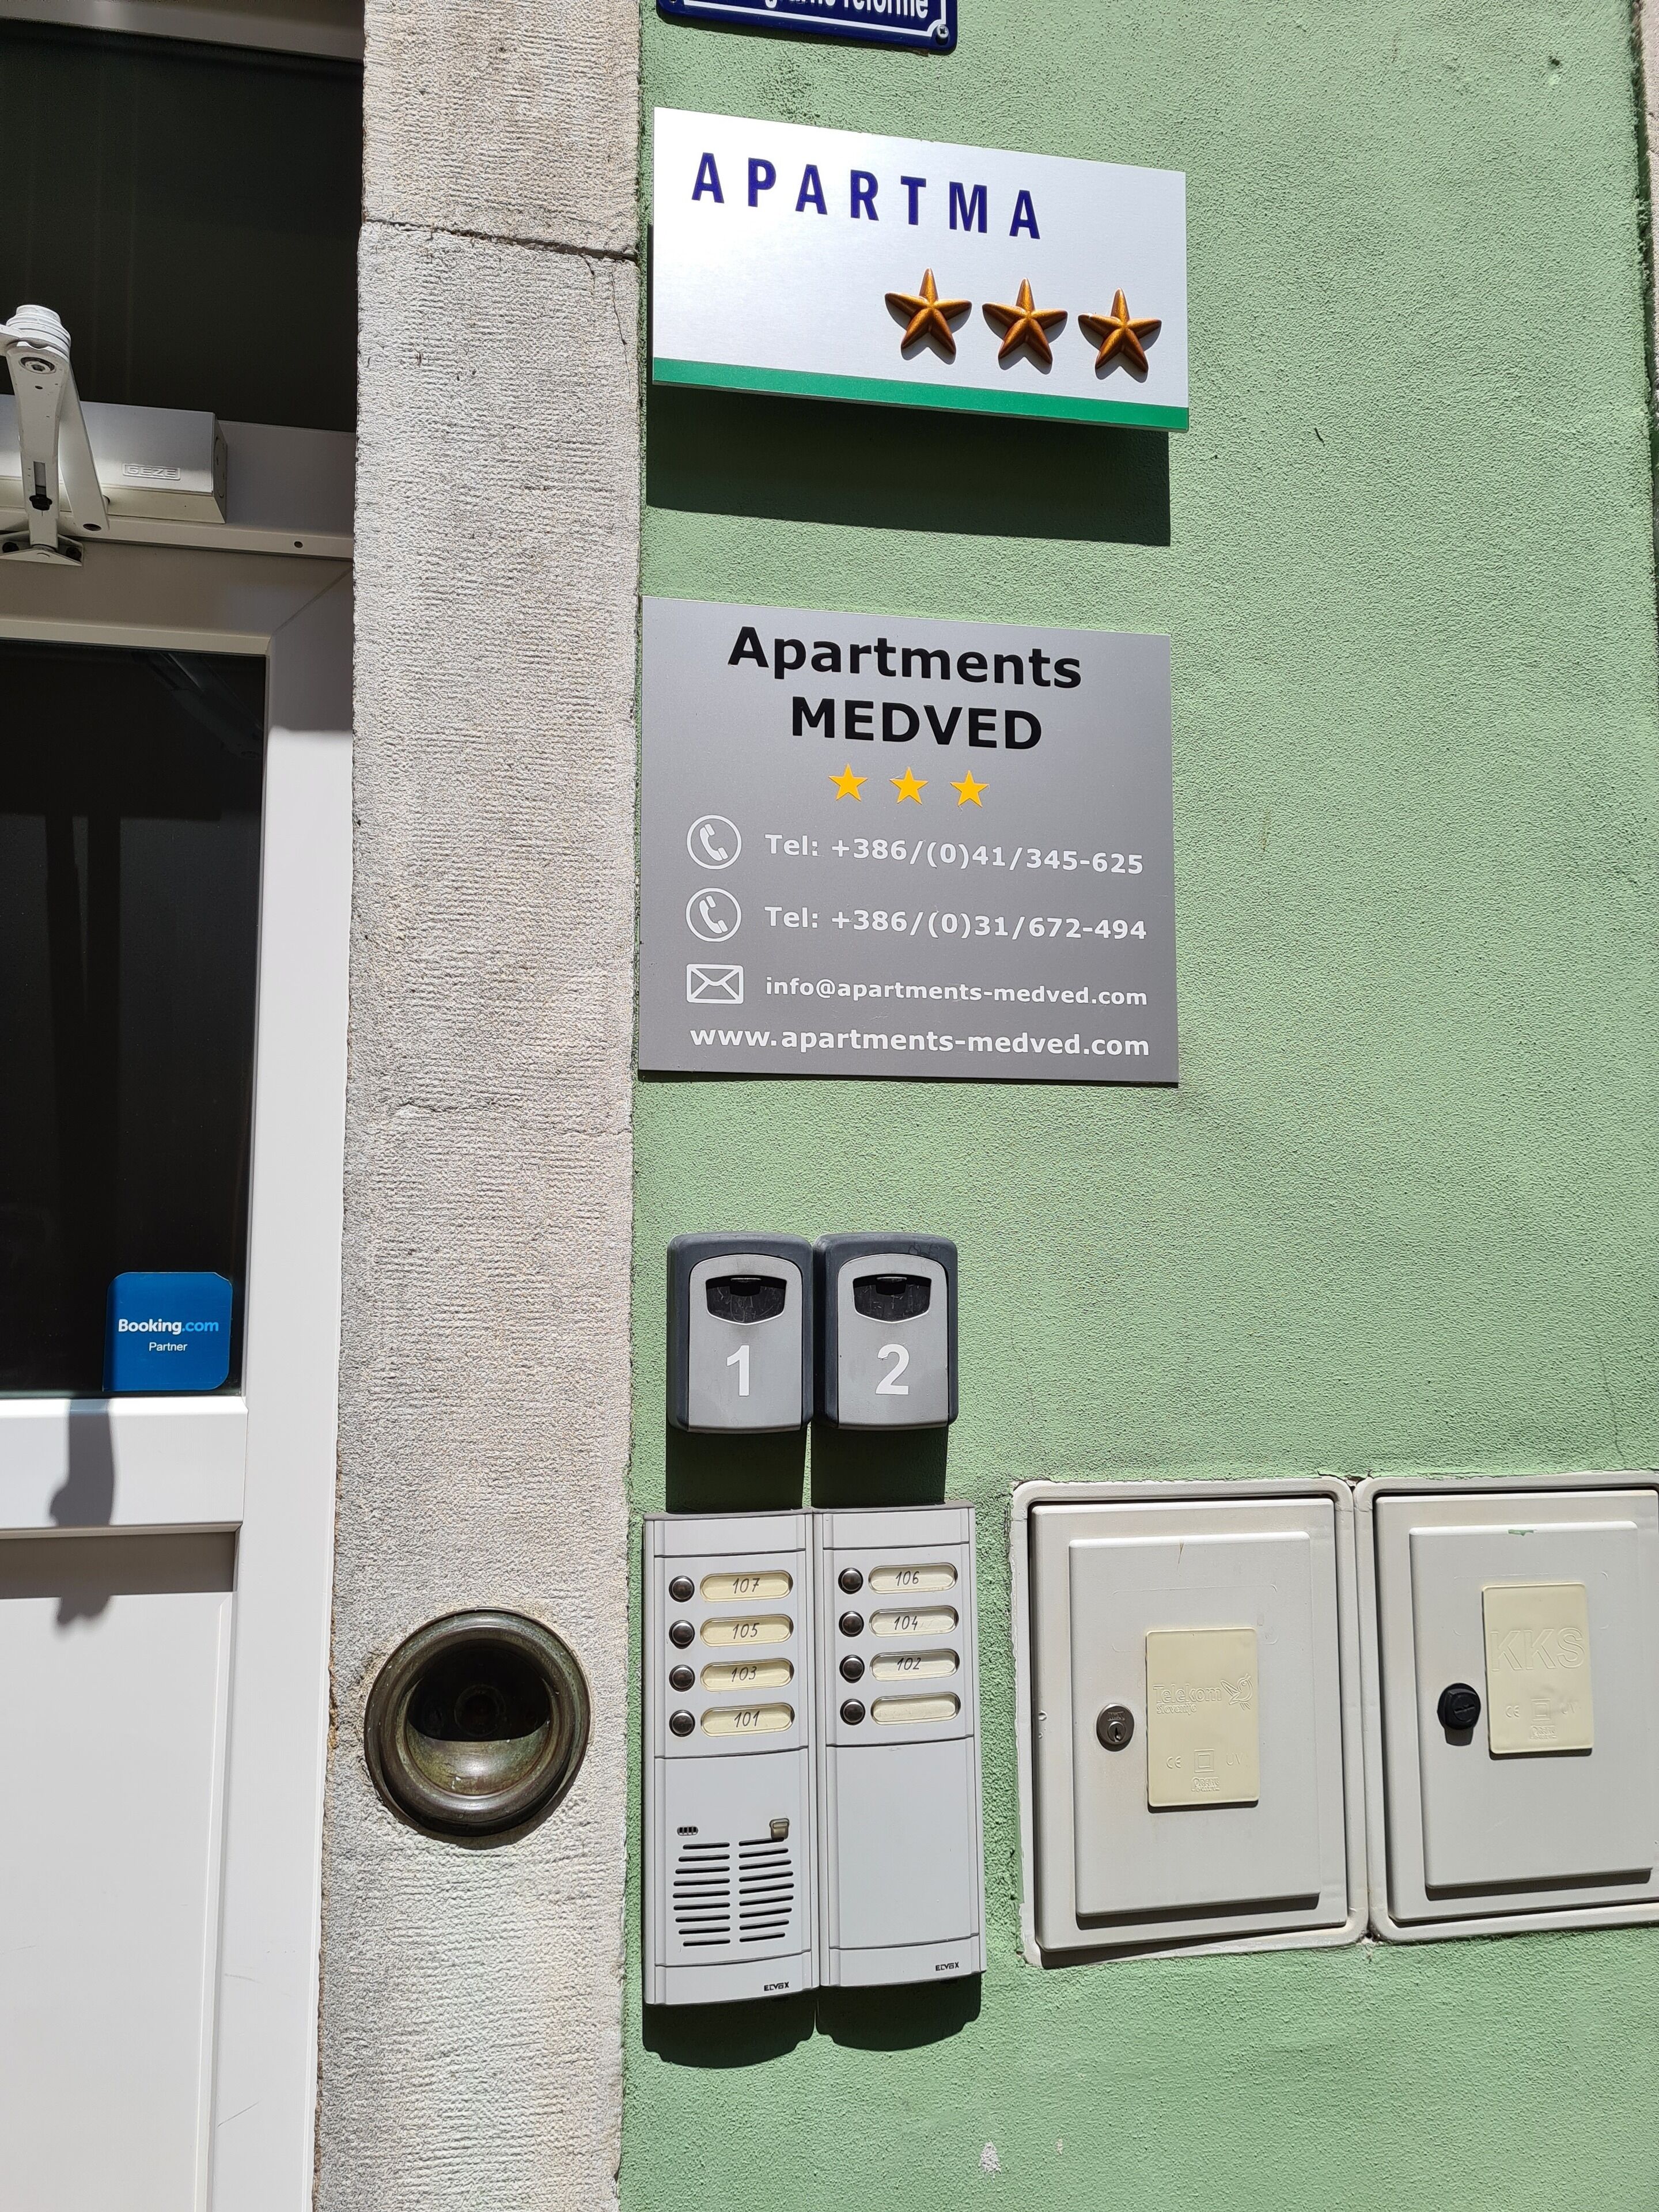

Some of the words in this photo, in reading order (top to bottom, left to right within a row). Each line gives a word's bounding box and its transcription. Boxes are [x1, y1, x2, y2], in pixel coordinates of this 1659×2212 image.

[692, 152, 1040, 240] APARTMA
[127, 465, 176, 478] GEZE
[728, 626, 1081, 689] Apartments
[792, 697, 1042, 750] MEDVED
[764, 834, 819, 857] Tel:
[831, 838, 1143, 874] +386/(0)41/345-625
[764, 906, 819, 929] Tel:
[831, 910, 1147, 940] +386/(0)31/672-494
[766, 976, 1147, 1006] info@apartments-medved.com
[690, 1028, 1149, 1056] www.apartments-medved.com
[118, 1319, 219, 1335] Booking.com
[149, 1342, 188, 1351] Partner
[726, 1345, 750, 1396] 1
[875, 1343, 910, 1395] 2
[732, 1577, 760, 1594] 107
[895, 1570, 920, 1587] 106
[732, 1622, 760, 1639] 105
[893, 1613, 919, 1631] 104
[1490, 1627, 1585, 1671] KKS
[730, 1665, 757, 1683] 103
[896, 1657, 922, 1672] 102
[1153, 1683, 1222, 1703] Telekom
[733, 1710, 760, 1728] 101
